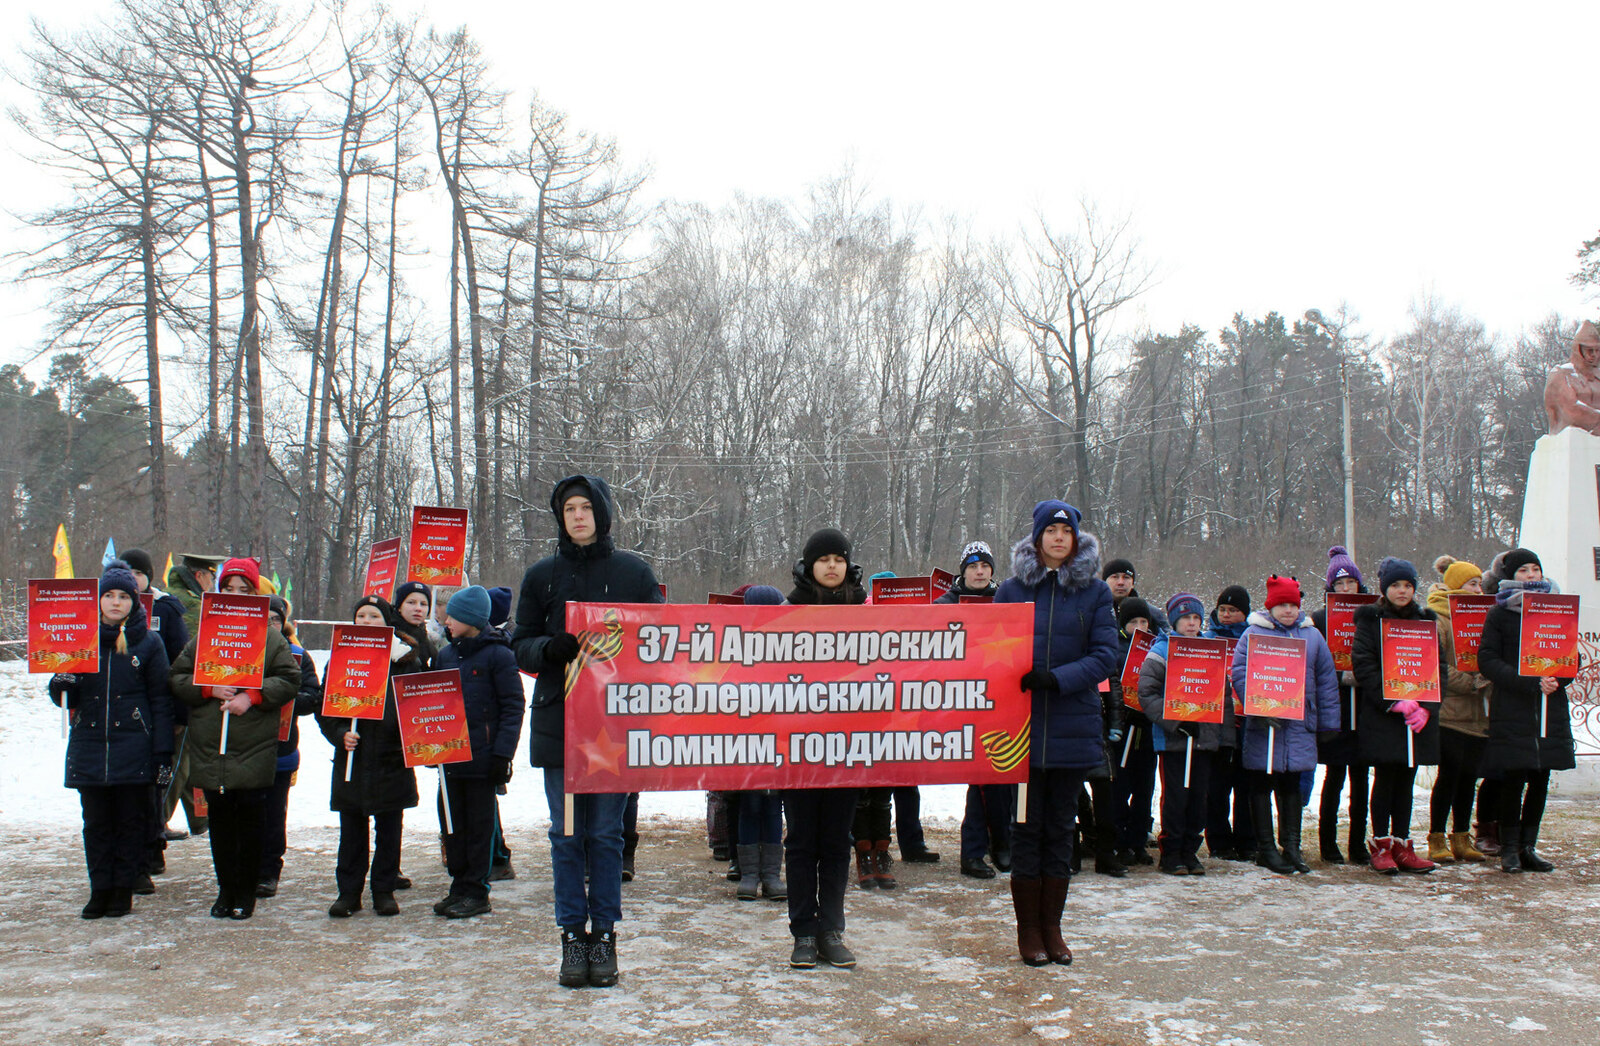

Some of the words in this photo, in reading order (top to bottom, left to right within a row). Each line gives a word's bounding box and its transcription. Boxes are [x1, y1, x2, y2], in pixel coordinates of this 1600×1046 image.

[436, 553, 446, 561] С.
[50, 612, 76, 620] рядовой
[40, 622, 87, 632] Черничко
[50, 634, 63, 642] М.
[66, 634, 76, 642] К.
[1534, 631, 1566, 640] Романов
[210, 638, 252, 648] Ильенко
[638, 624, 714, 662] 37-й
[721, 622, 965, 665] Армавирский
[218, 650, 230, 658] М.
[234, 650, 242, 659] Г.
[1397, 658, 1421, 667] Кутья
[1400, 668, 1409, 676] Н.
[1253, 672, 1296, 684] Коновалов
[346, 678, 355, 688] П.
[357, 679, 366, 688] Я.
[1264, 683, 1272, 691] Е.
[1274, 684, 1284, 692] М.
[1194, 686, 1204, 694] С.
[606, 674, 894, 716] кавалерийский
[902, 680, 994, 711] полк.
[419, 704, 444, 712] рядовой
[412, 714, 456, 724] Савченко
[425, 726, 434, 734] Г.
[628, 730, 783, 767] Помним,
[790, 725, 974, 768] гордимся!
